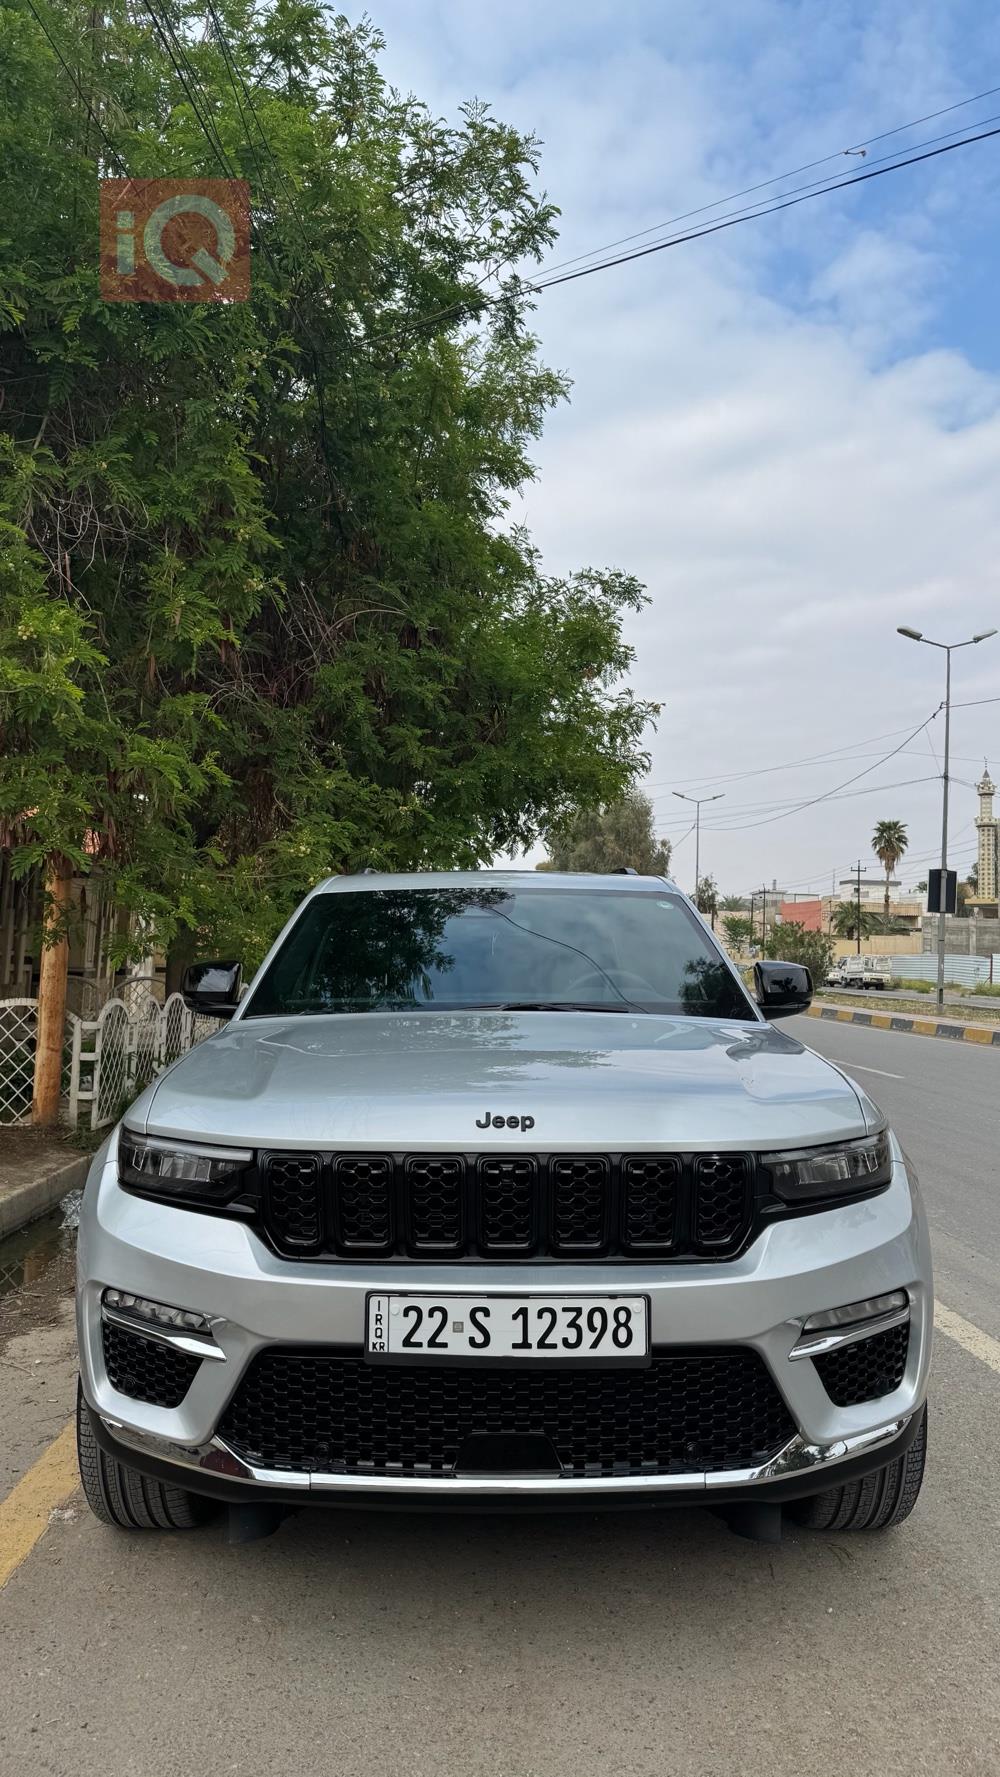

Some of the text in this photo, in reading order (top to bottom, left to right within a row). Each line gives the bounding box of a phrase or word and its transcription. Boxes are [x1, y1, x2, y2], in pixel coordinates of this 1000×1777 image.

[475, 1111, 535, 1132] Jeep
[402, 1305, 633, 1350] 22 S 12398
[371, 1341, 385, 1352] KR
